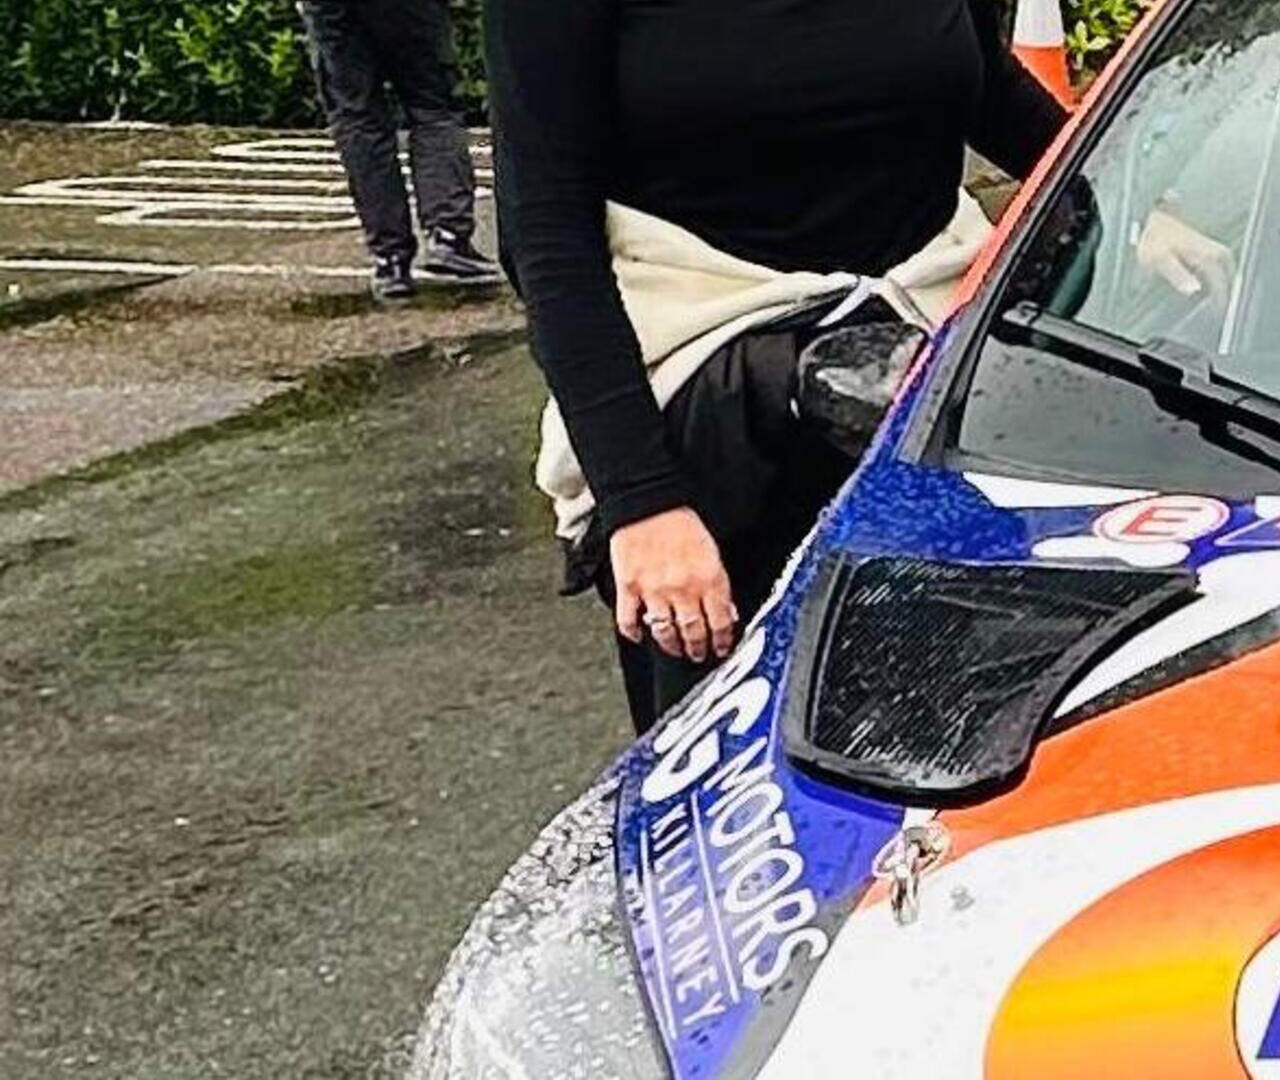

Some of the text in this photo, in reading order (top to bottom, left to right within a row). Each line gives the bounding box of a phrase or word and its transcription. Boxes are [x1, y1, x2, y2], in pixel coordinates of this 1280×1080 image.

[640, 626, 771, 803] BG
[649, 802, 726, 1026] KILLARNEY
[703, 735, 829, 992] MOTORS
